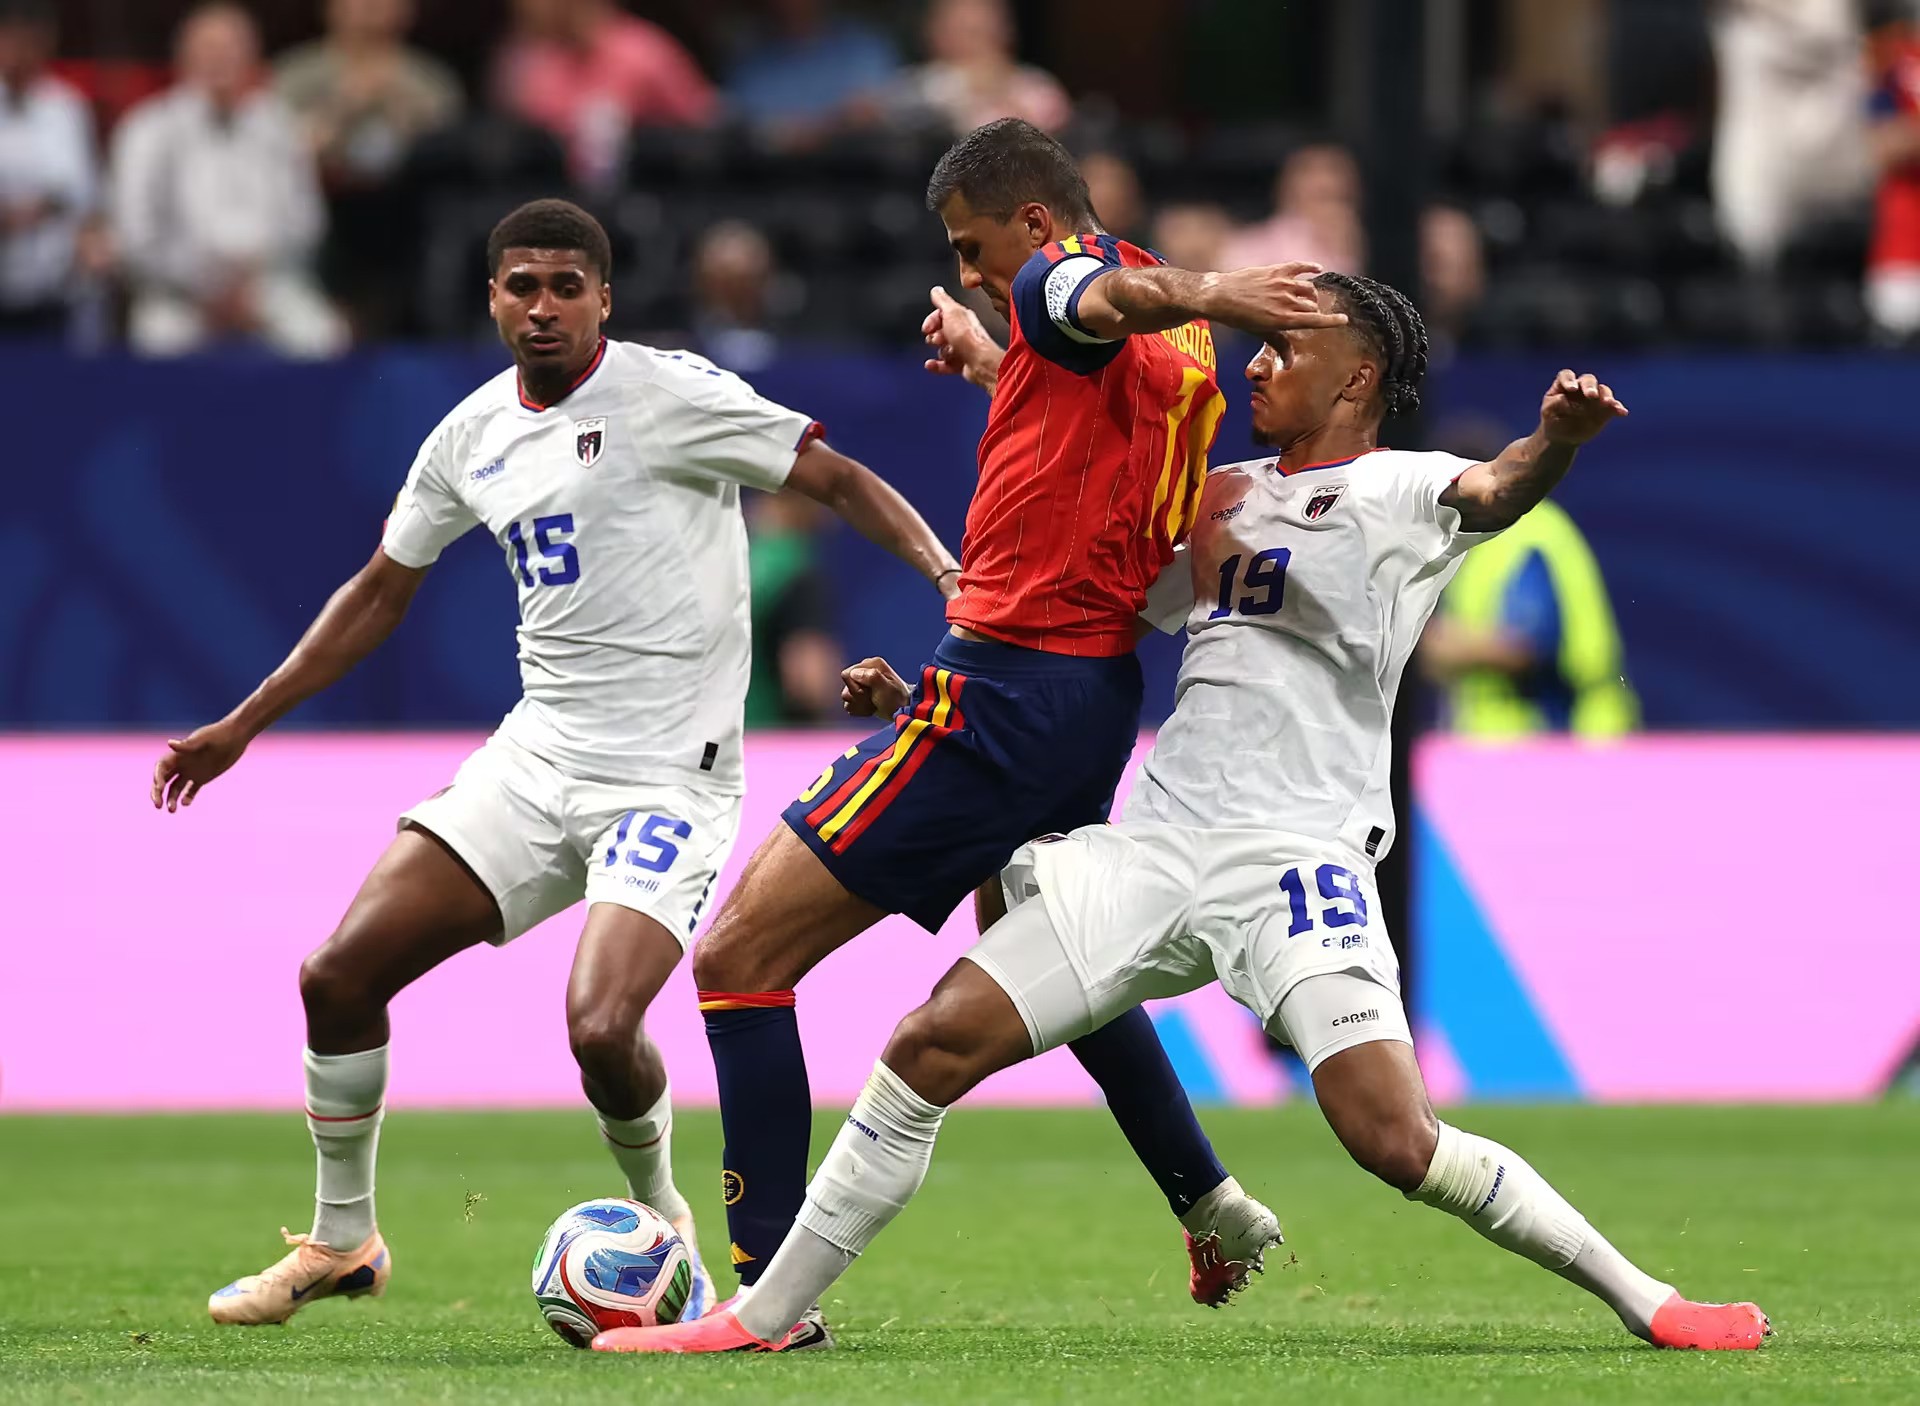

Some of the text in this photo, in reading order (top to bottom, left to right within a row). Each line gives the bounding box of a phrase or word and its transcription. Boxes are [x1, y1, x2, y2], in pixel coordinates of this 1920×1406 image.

[470, 457, 505, 481] capelli
[1315, 486, 1344, 494] FCF
[1210, 500, 1246, 521] capelli
[508, 512, 580, 588] 15
[1208, 547, 1292, 621] 19
[605, 808, 693, 873] 15
[1279, 864, 1368, 938] 19
[1332, 1008, 1379, 1027] capelli
